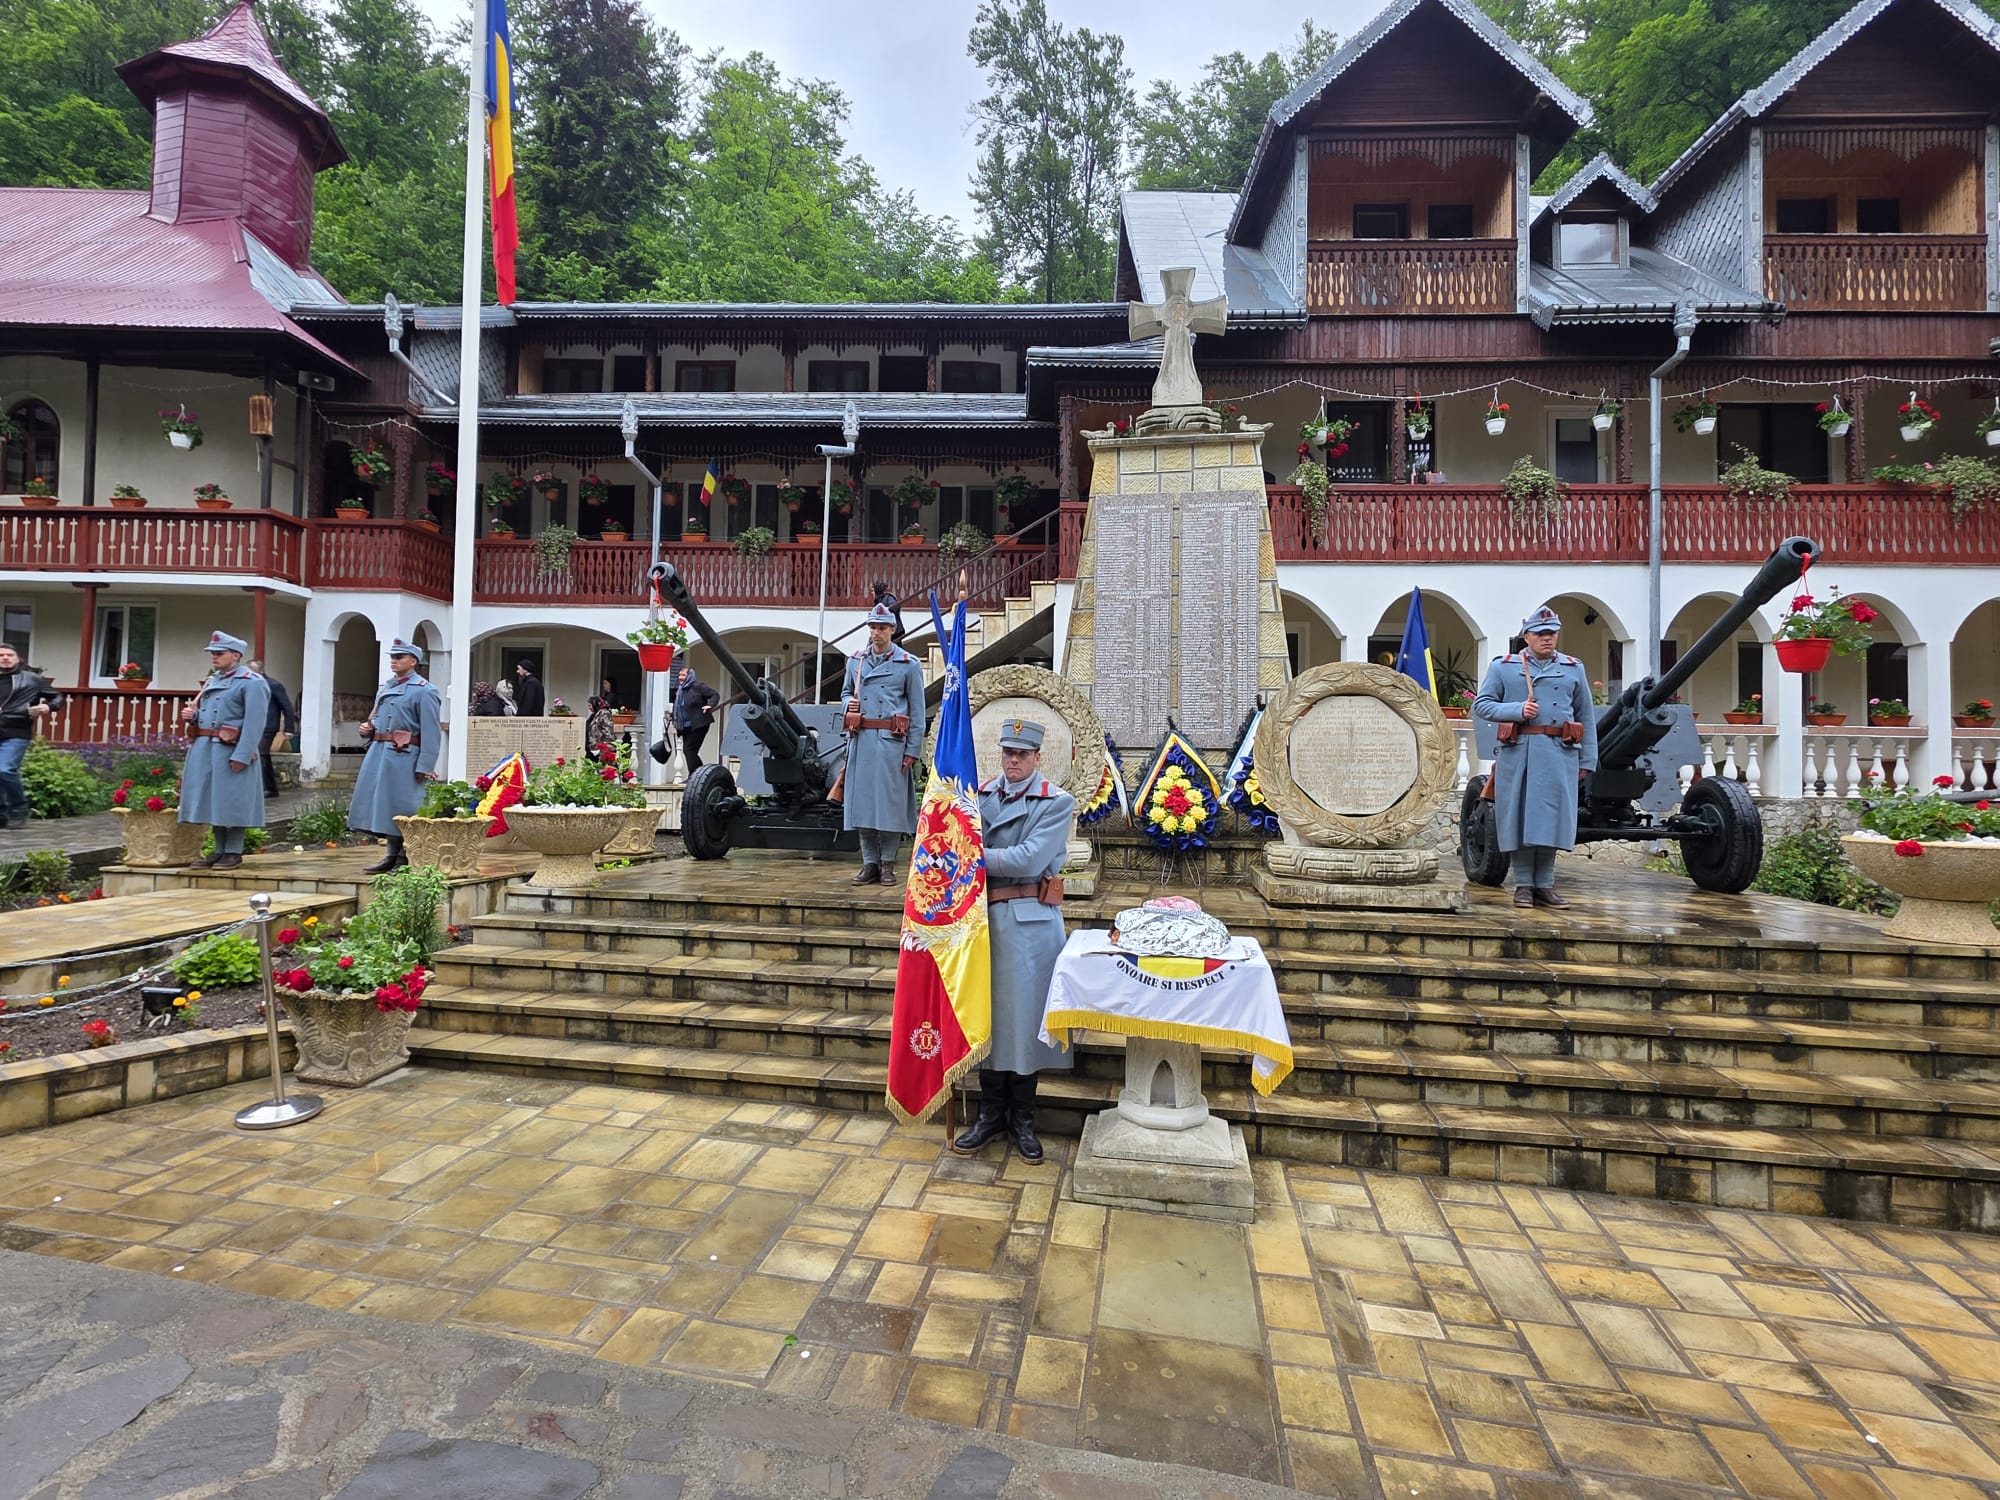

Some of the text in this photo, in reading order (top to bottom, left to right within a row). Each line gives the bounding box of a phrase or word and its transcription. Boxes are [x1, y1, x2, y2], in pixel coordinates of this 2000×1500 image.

[1116, 959, 1225, 990] ONOARE SI RESPECT
